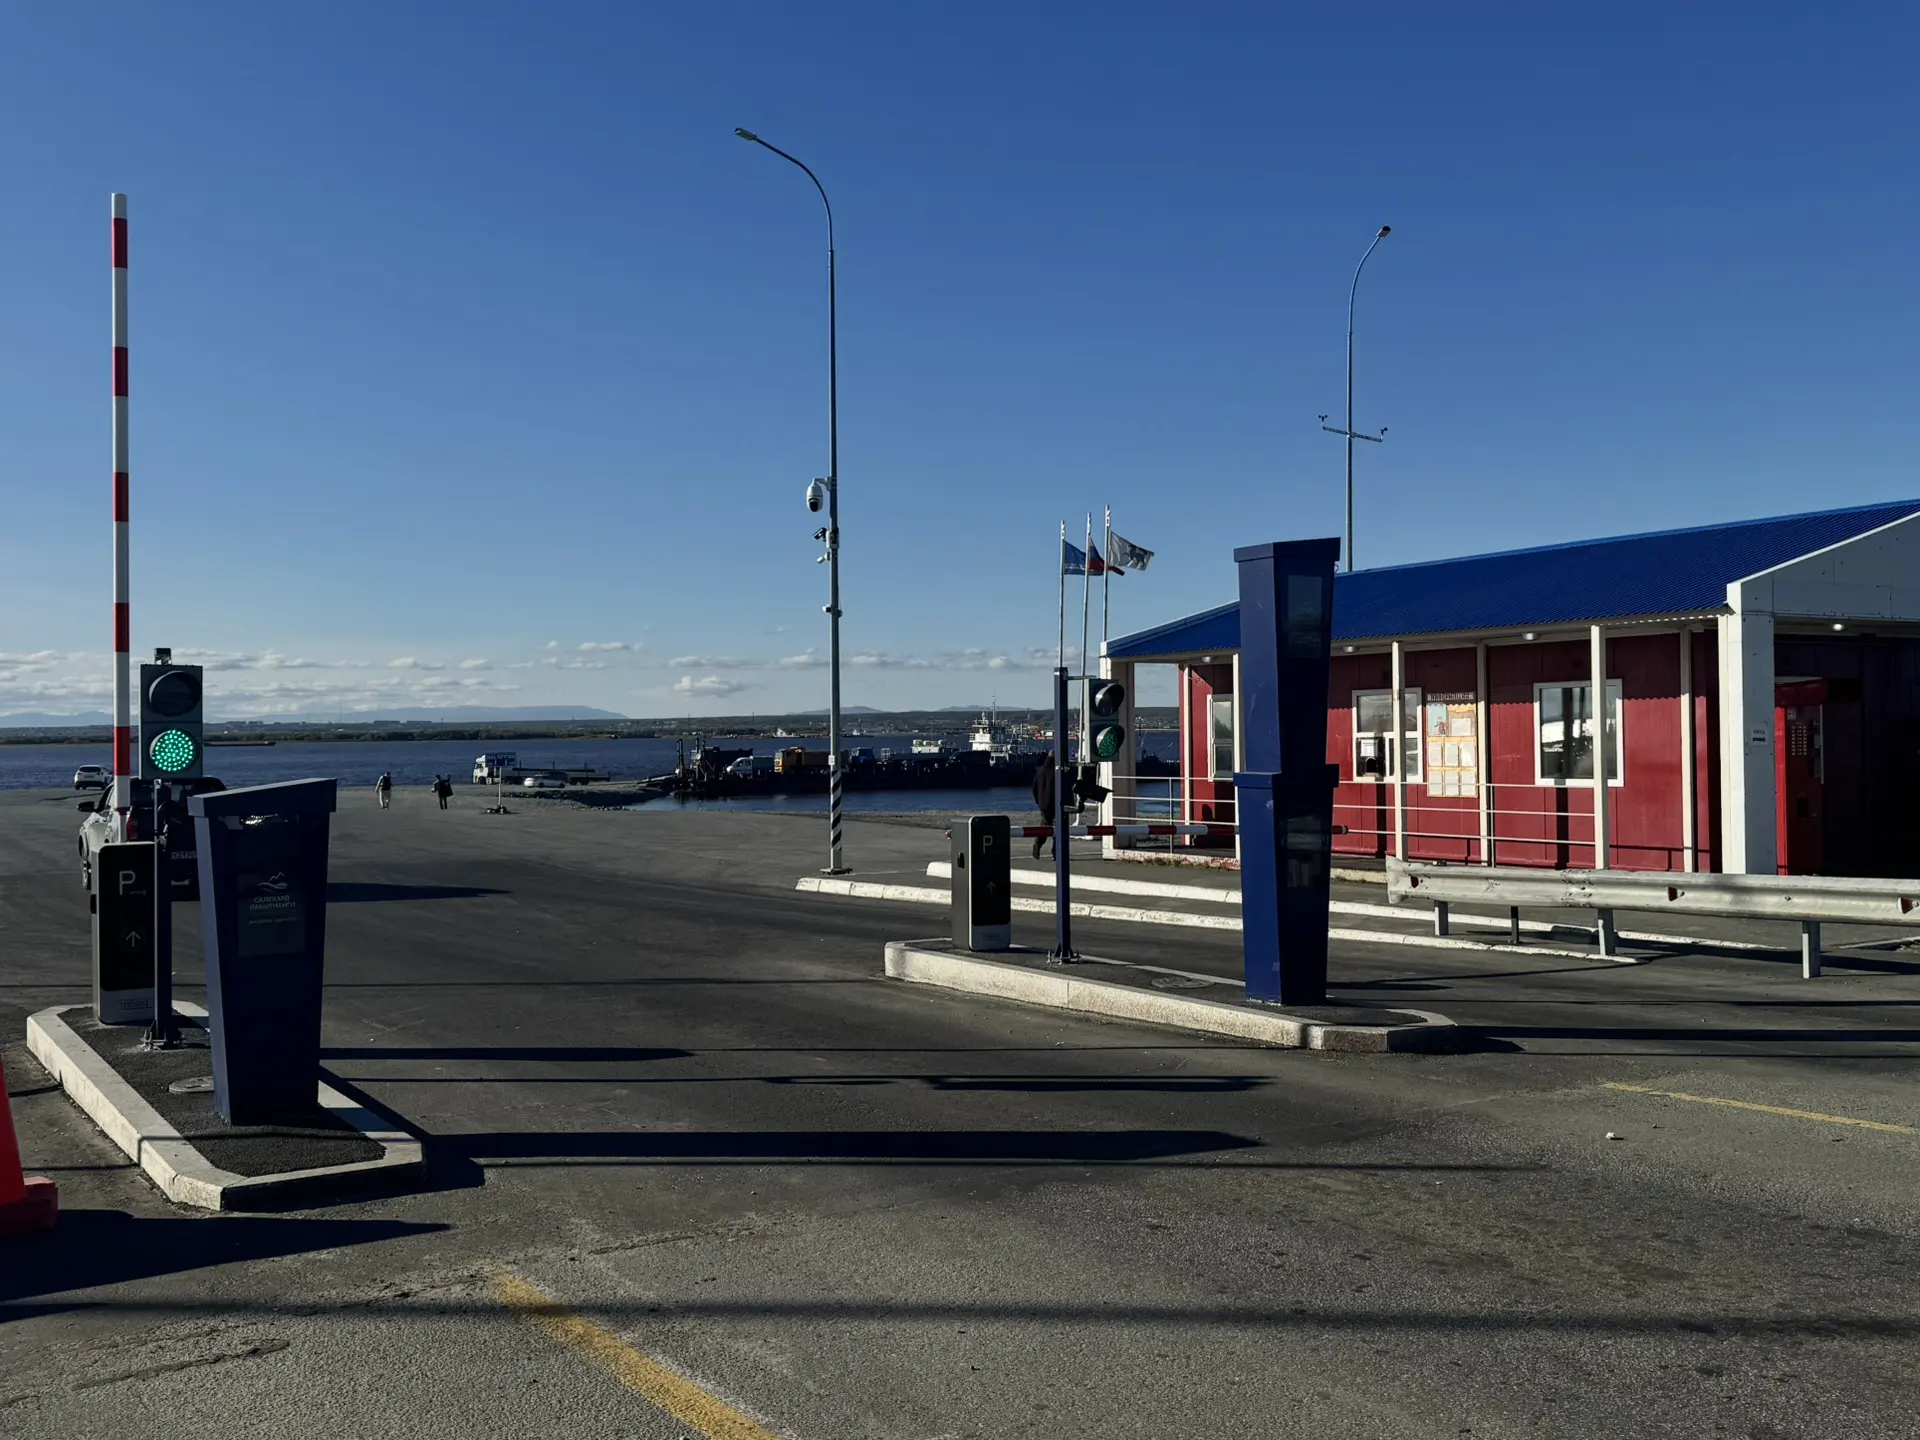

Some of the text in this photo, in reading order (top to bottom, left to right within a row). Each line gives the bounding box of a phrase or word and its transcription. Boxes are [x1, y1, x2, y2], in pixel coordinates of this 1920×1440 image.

[983, 835, 993, 855] P
[118, 870, 136, 896] P
[254, 894, 290, 903] САЛЕХАРД
